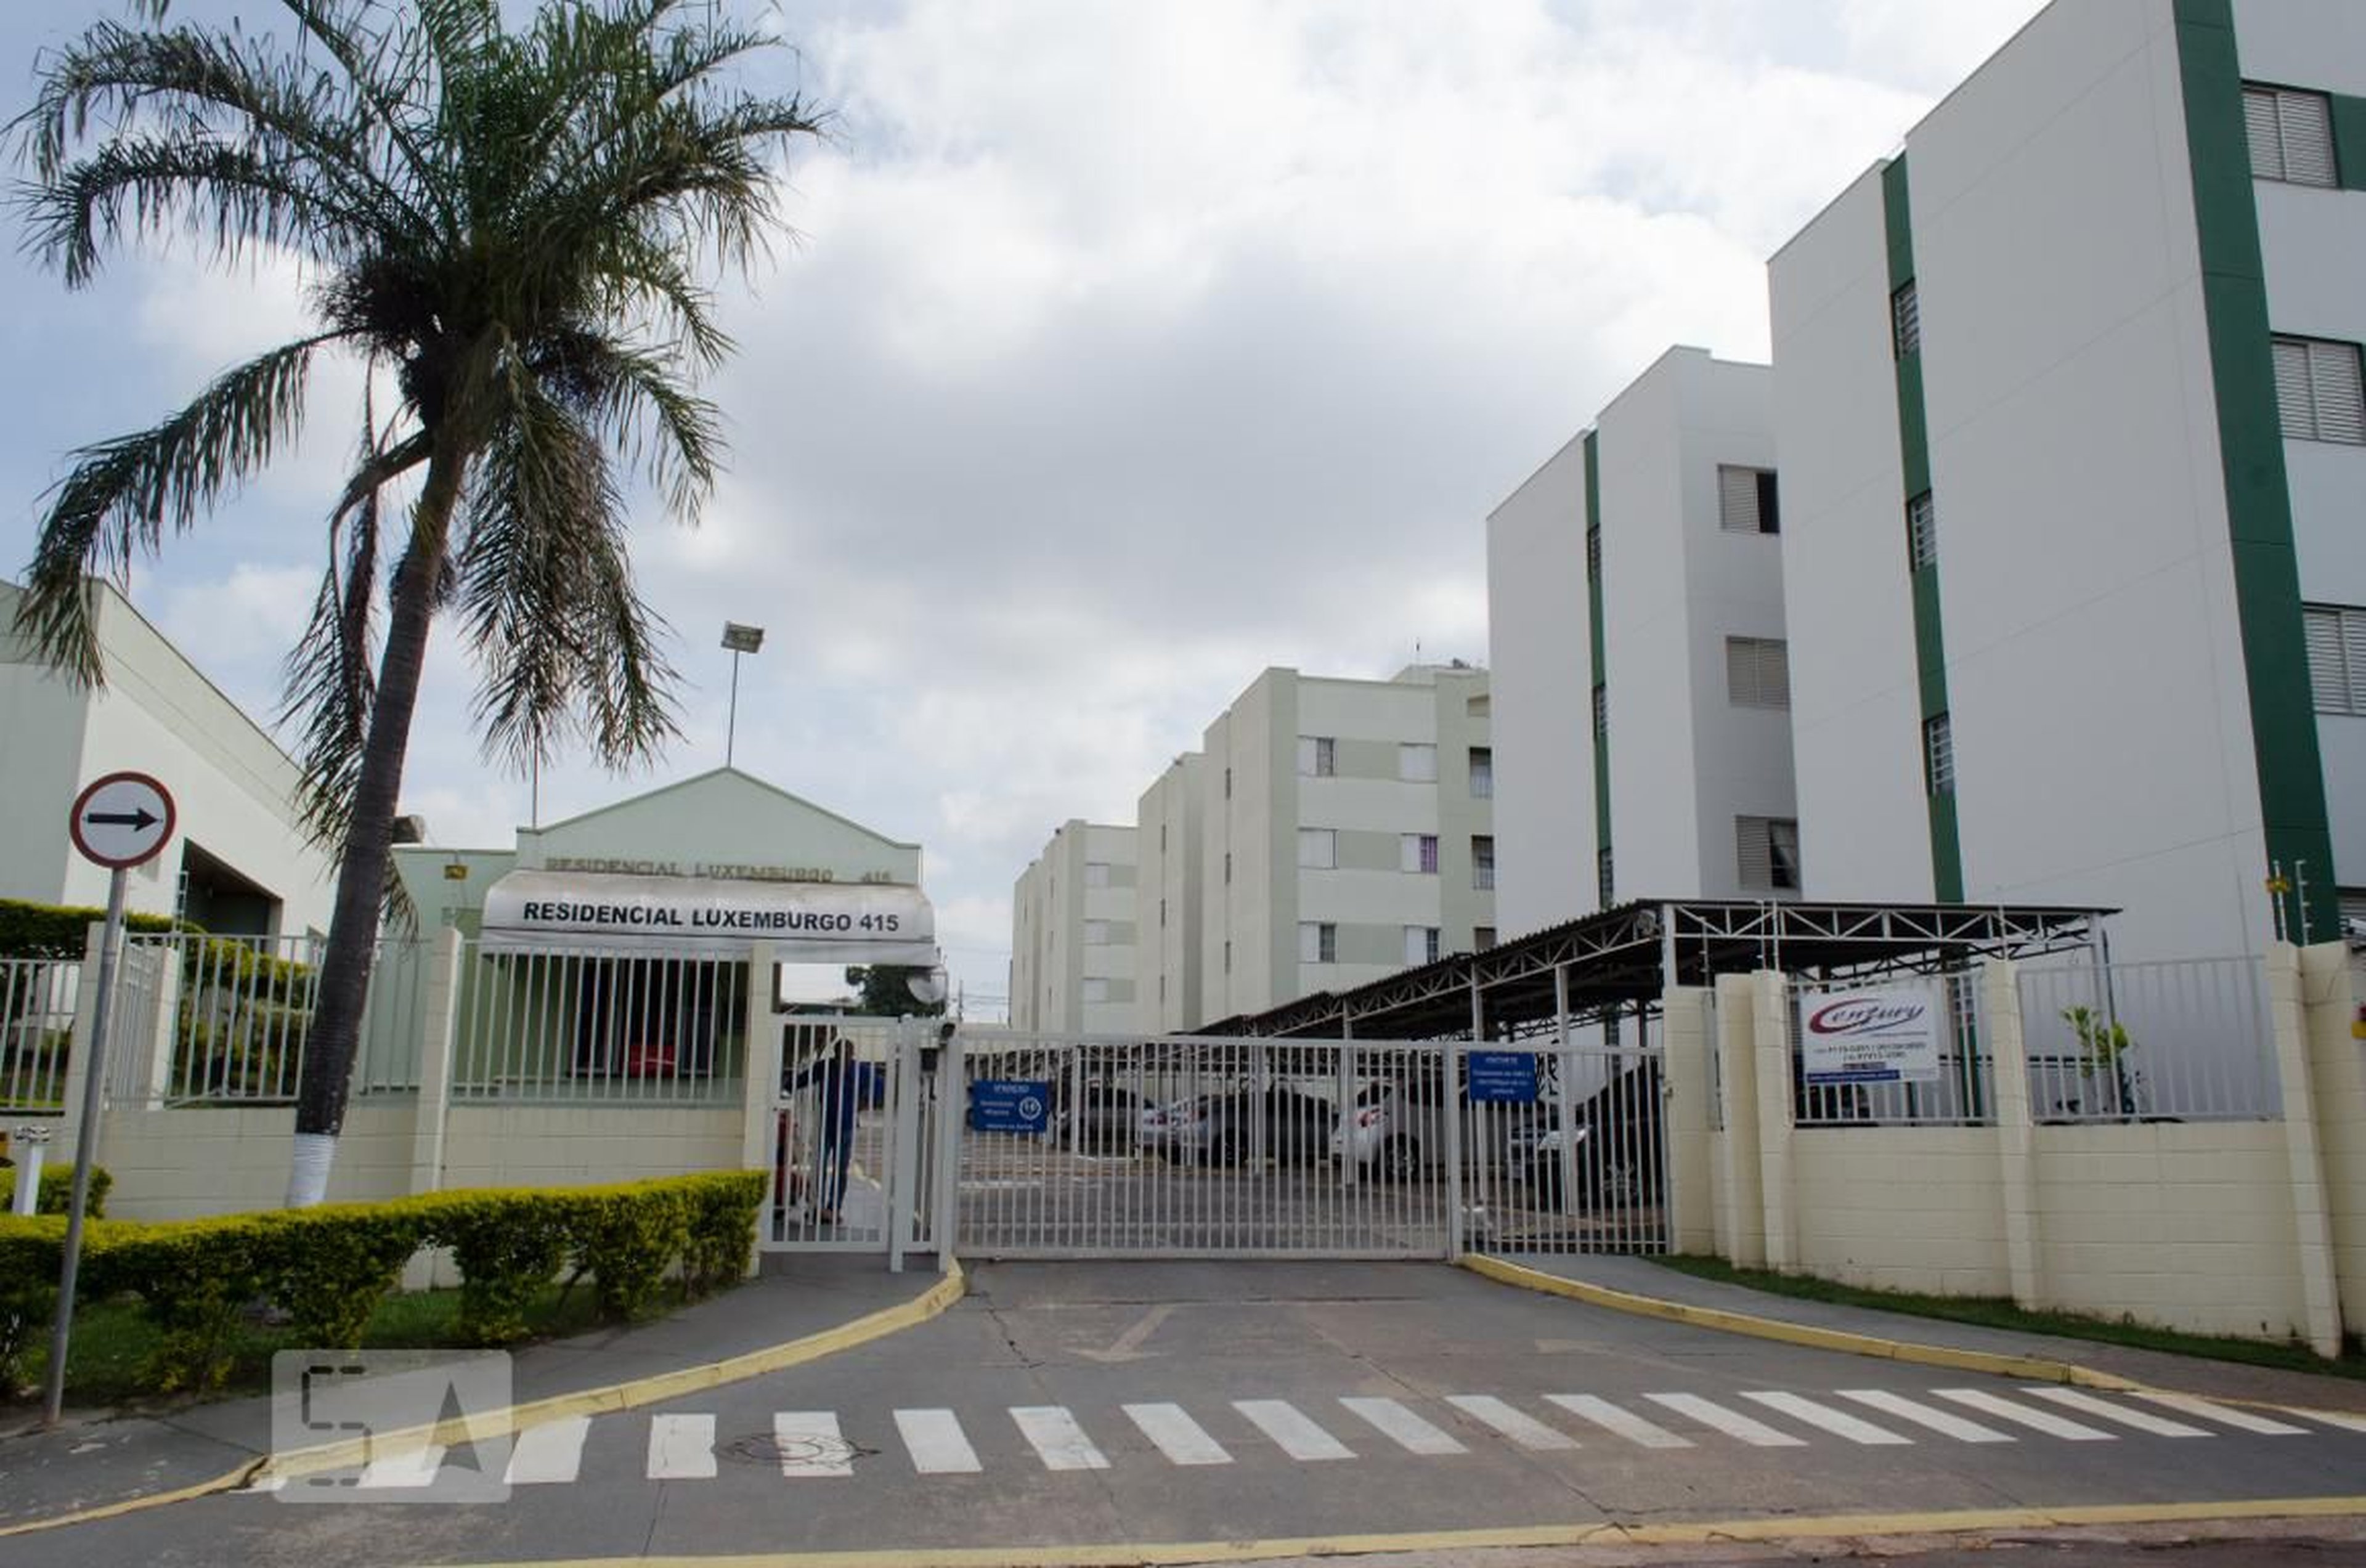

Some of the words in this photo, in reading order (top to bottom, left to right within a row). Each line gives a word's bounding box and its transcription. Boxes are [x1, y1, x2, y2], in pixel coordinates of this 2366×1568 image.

[545, 857, 680, 876] RESIDENCIAL
[694, 862, 834, 882] LUXEMBURGO
[523, 902, 683, 925] RESIDENCIAL
[692, 909, 852, 931] LUXEMBURGO
[860, 914, 899, 932] 415
